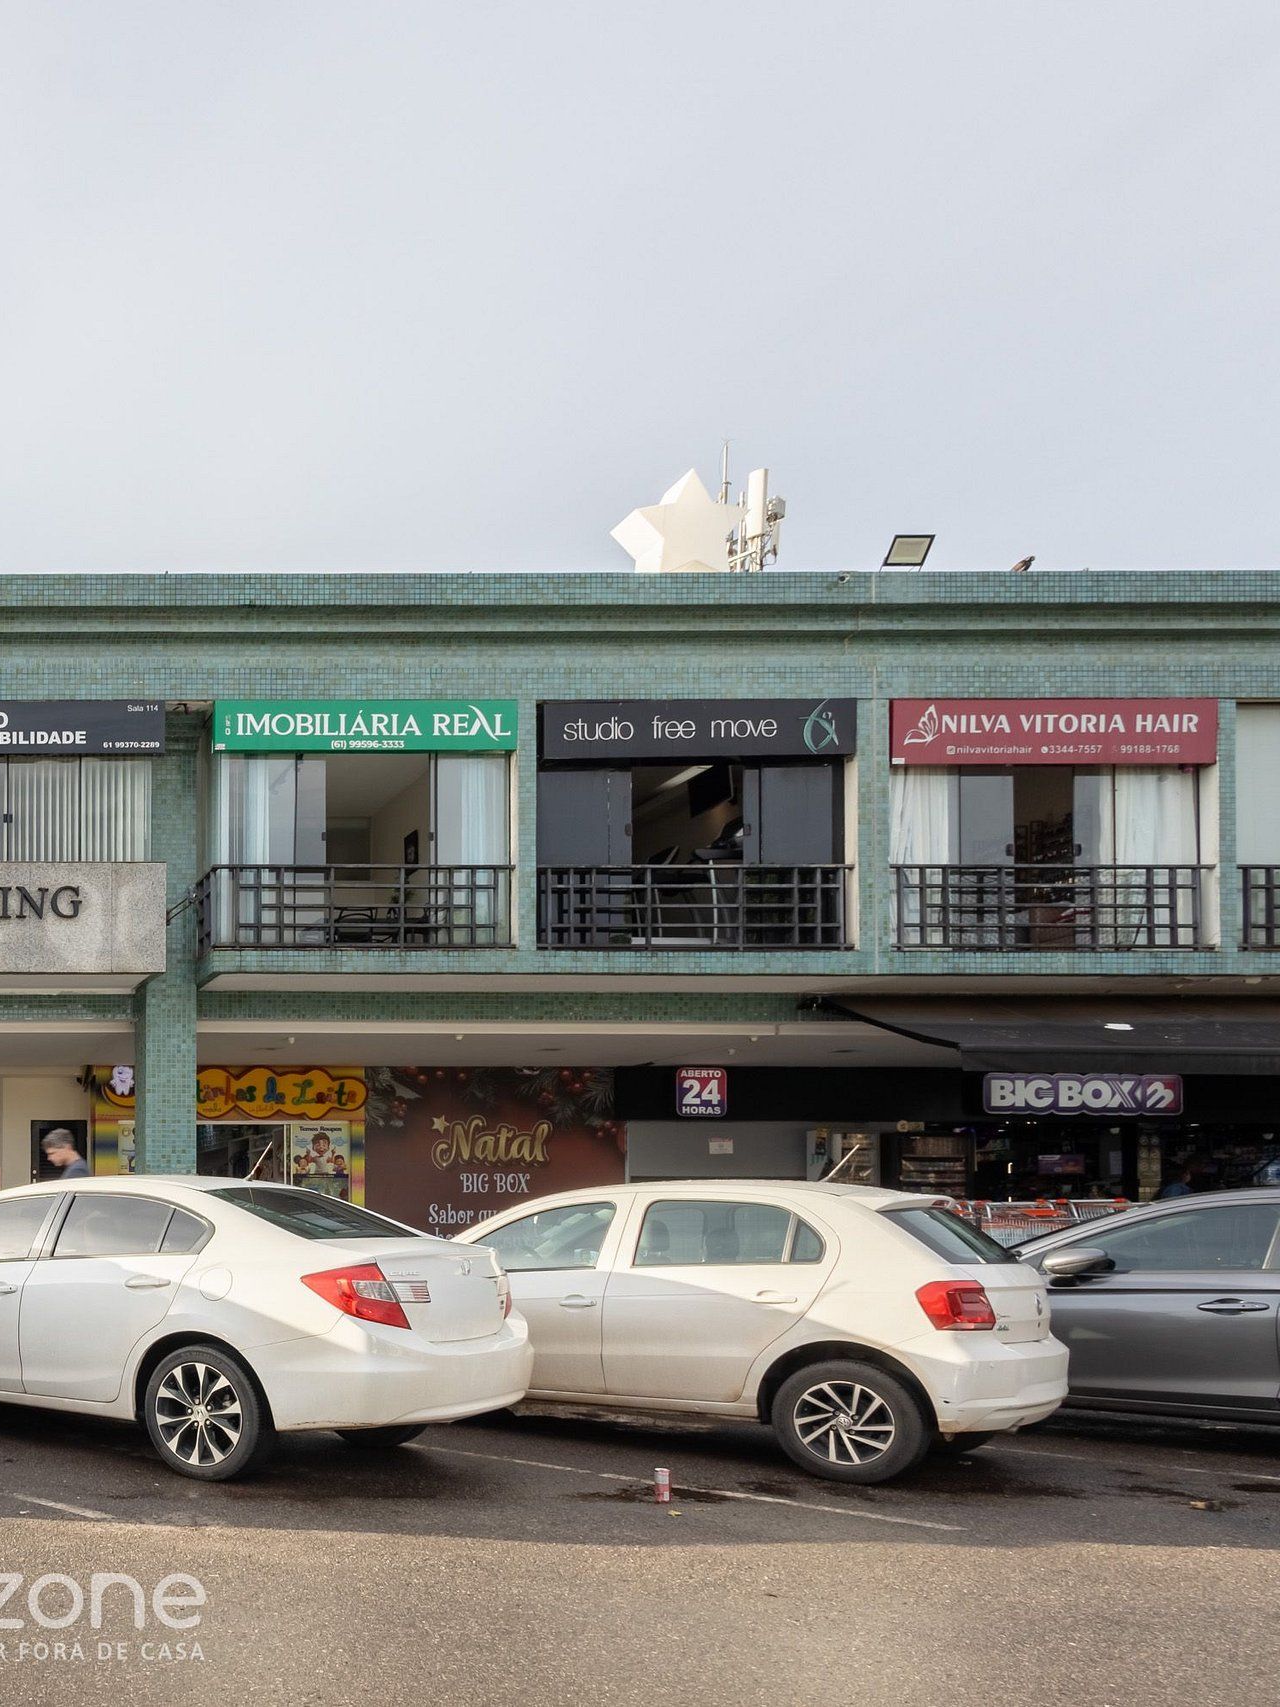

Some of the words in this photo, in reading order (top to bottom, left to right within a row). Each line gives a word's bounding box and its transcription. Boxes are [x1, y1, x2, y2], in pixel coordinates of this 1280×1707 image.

[127, 704, 144, 712] Sala
[146, 704, 159, 712] 114
[236, 709, 421, 736] IMOBILIÁRIA
[432, 705, 512, 741] REAL
[563, 717, 634, 741] studio
[651, 715, 696, 739] free
[710, 718, 778, 739] move
[941, 714, 1011, 734] NILVA
[1020, 714, 1125, 734] VITORIA
[1135, 713, 1199, 733] HAIR
[103, 741, 112, 749] 61
[330, 740, 347, 750] (61)
[348, 740, 405, 748] 99596-3333
[1049, 744, 1102, 754] 3344-7557
[680, 1070, 721, 1078] ABERTO
[292, 1079, 358, 1106] Leite
[682, 1079, 721, 1105] 24
[990, 1079, 1055, 1108] BIG
[1058, 1080, 1136, 1108] BOX
[682, 1106, 721, 1115] HORAS
[433, 1116, 551, 1168] Natal
[460, 1173, 489, 1193] BIG
[494, 1173, 530, 1193] BOX
[428, 1204, 474, 1224] Sabor
